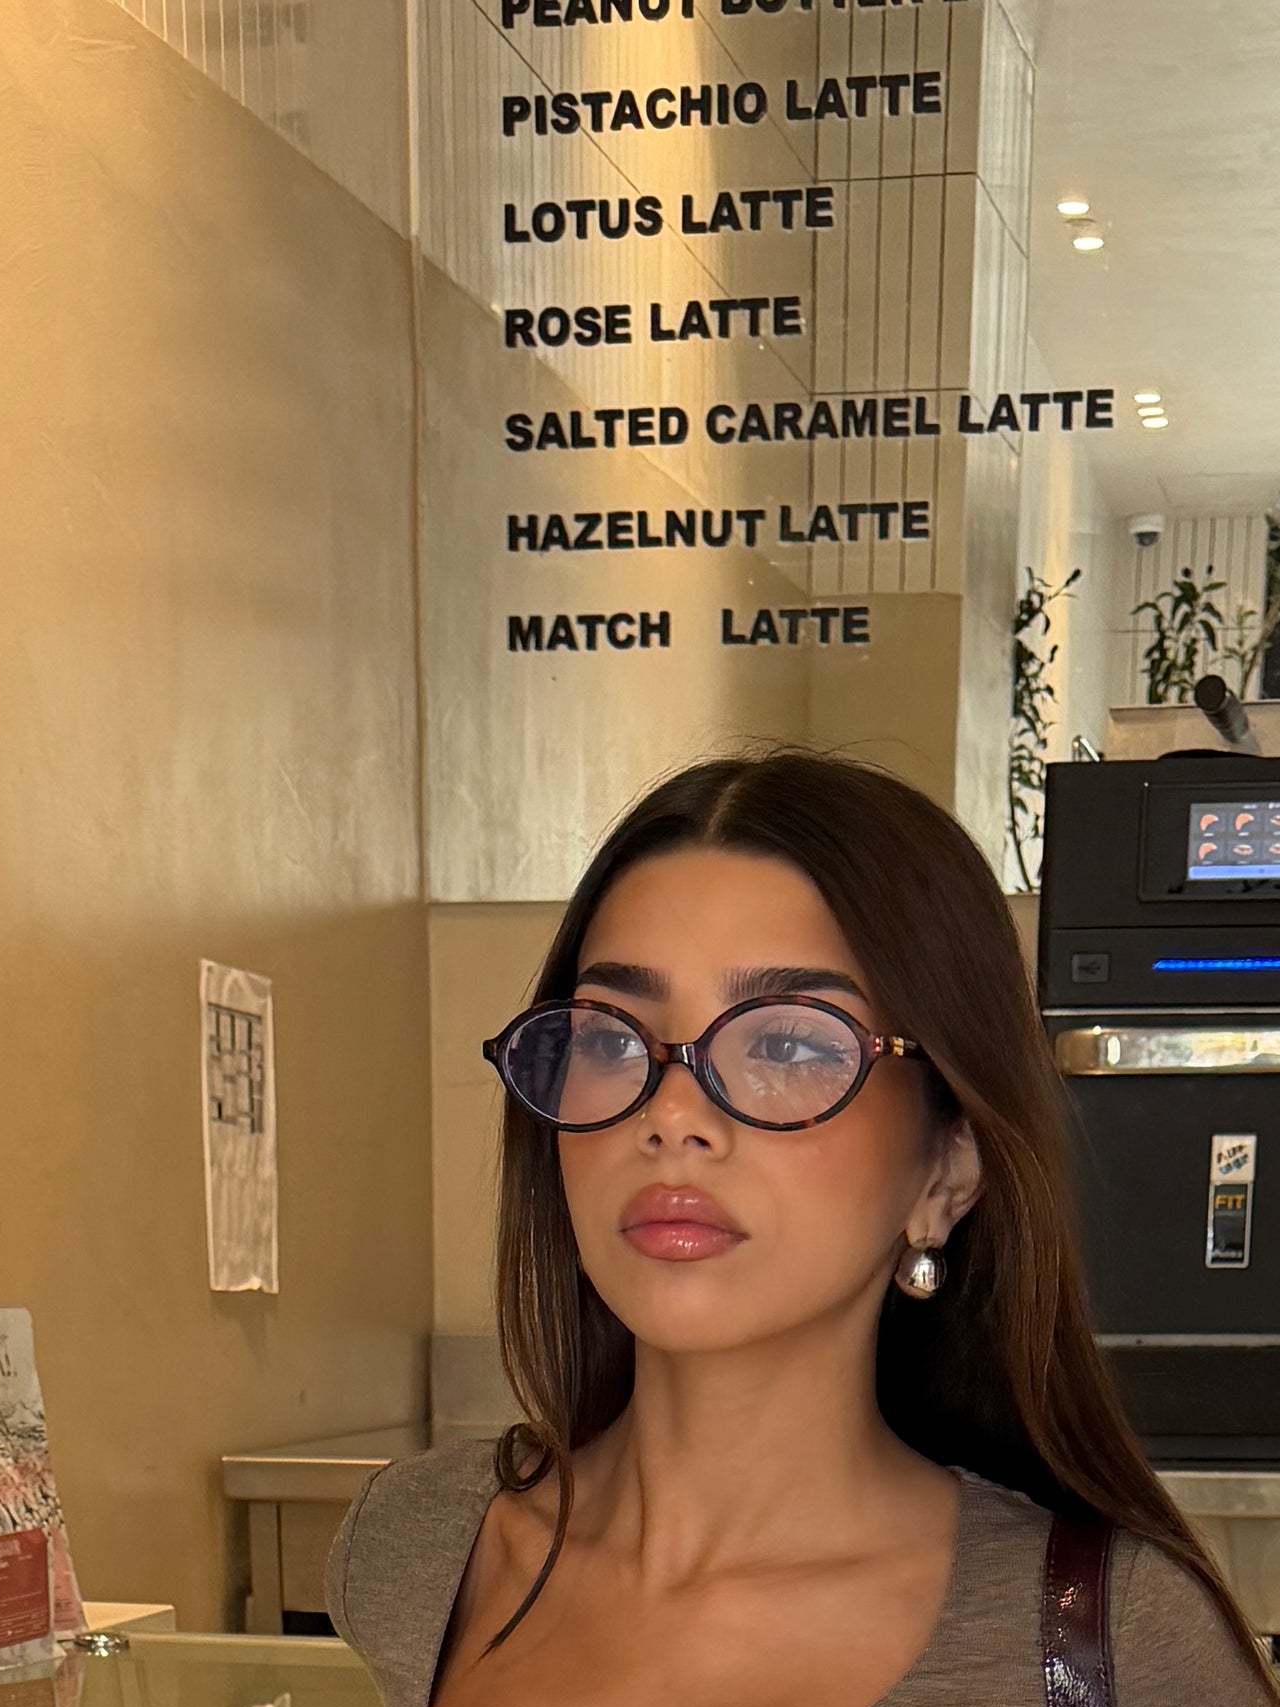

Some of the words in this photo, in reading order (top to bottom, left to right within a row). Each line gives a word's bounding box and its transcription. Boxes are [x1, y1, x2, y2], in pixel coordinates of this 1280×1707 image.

[502, 82, 767, 137] PISTACHIO
[785, 71, 942, 121] LATTE
[504, 196, 663, 243] LOTUS
[681, 186, 835, 234] LATTE
[505, 304, 632, 349] ROSE
[650, 296, 802, 342] LATTE
[505, 407, 688, 452] SALTED
[706, 396, 941, 444] CARAMEL
[957, 389, 1115, 434] LATTE
[508, 508, 766, 552] HAZELNUT
[779, 501, 930, 543] LATTE
[508, 611, 671, 652] MATCH
[721, 606, 870, 645] LATTE
